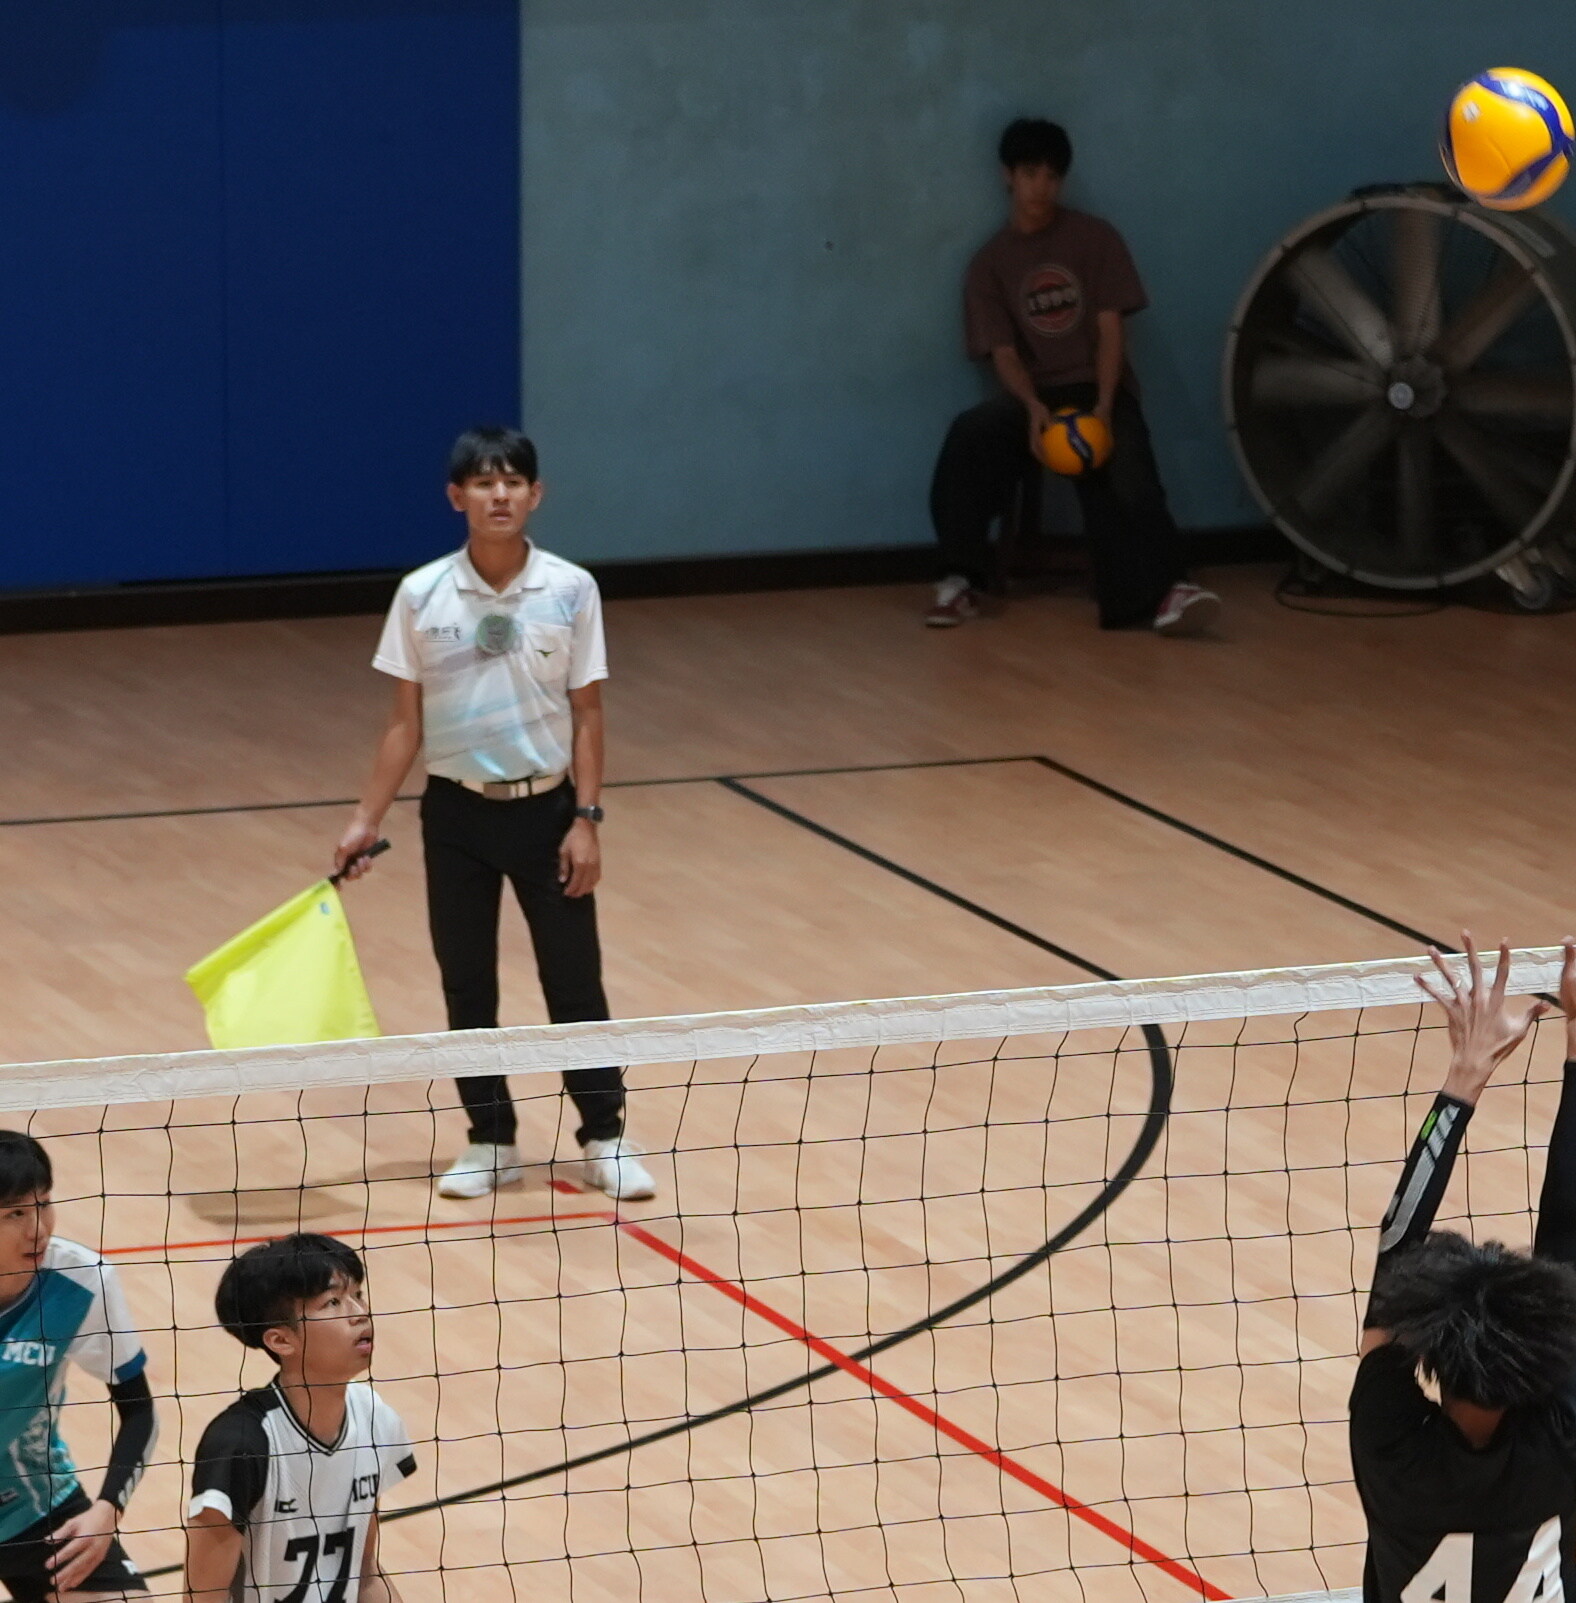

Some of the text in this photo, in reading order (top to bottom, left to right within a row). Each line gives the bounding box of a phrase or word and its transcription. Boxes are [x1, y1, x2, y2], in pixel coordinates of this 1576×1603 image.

[2, 1338, 56, 1367] MCU
[274, 1527, 355, 1603] 77
[1400, 1514, 1566, 1603] 44
